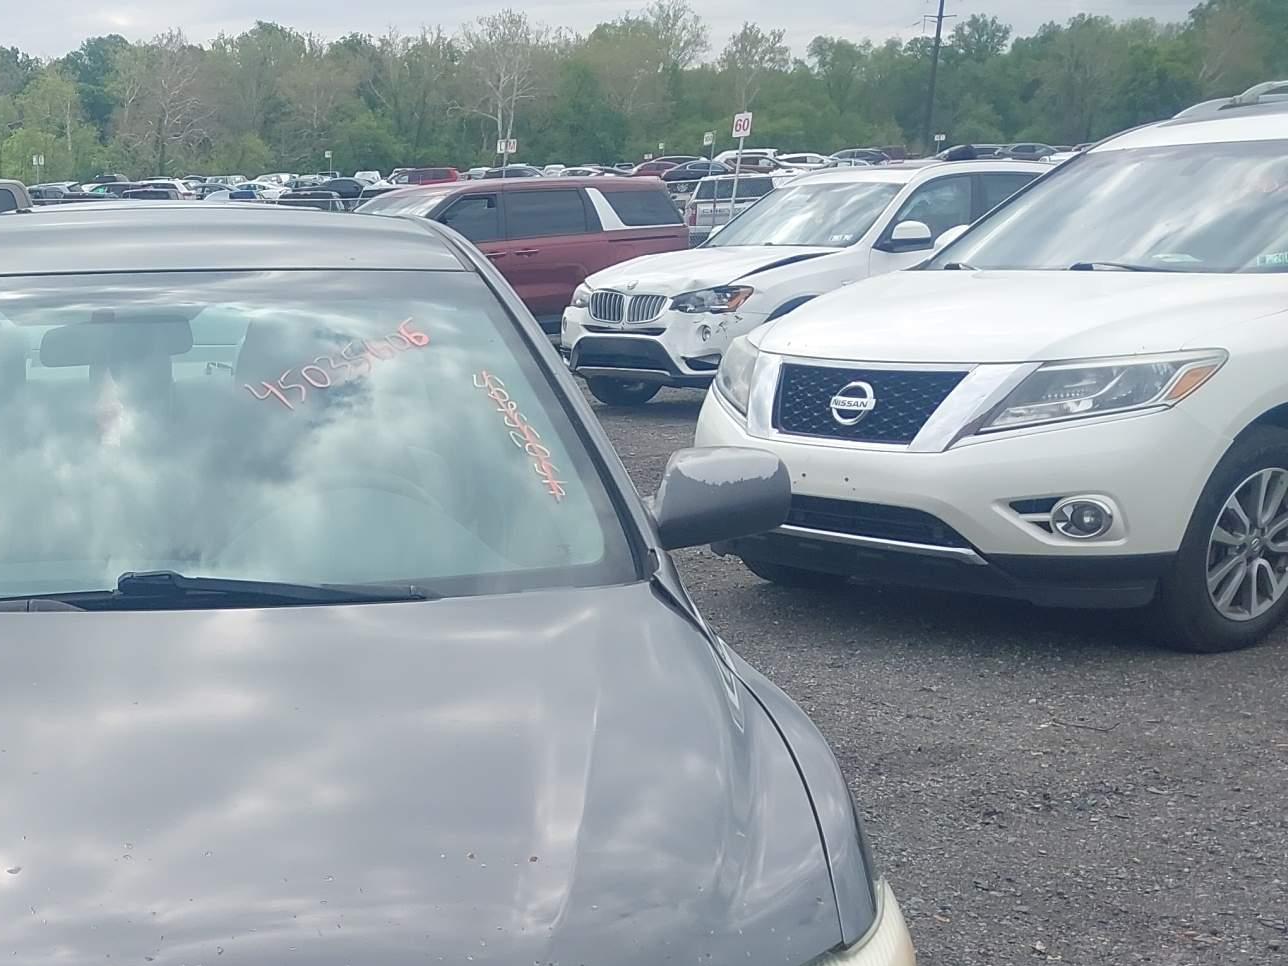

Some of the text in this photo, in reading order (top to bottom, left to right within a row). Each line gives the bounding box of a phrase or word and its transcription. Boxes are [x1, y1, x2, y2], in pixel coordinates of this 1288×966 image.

[735, 118, 750, 132] 60
[244, 317, 430, 411] 45035606
[832, 399, 868, 408] NISSAN
